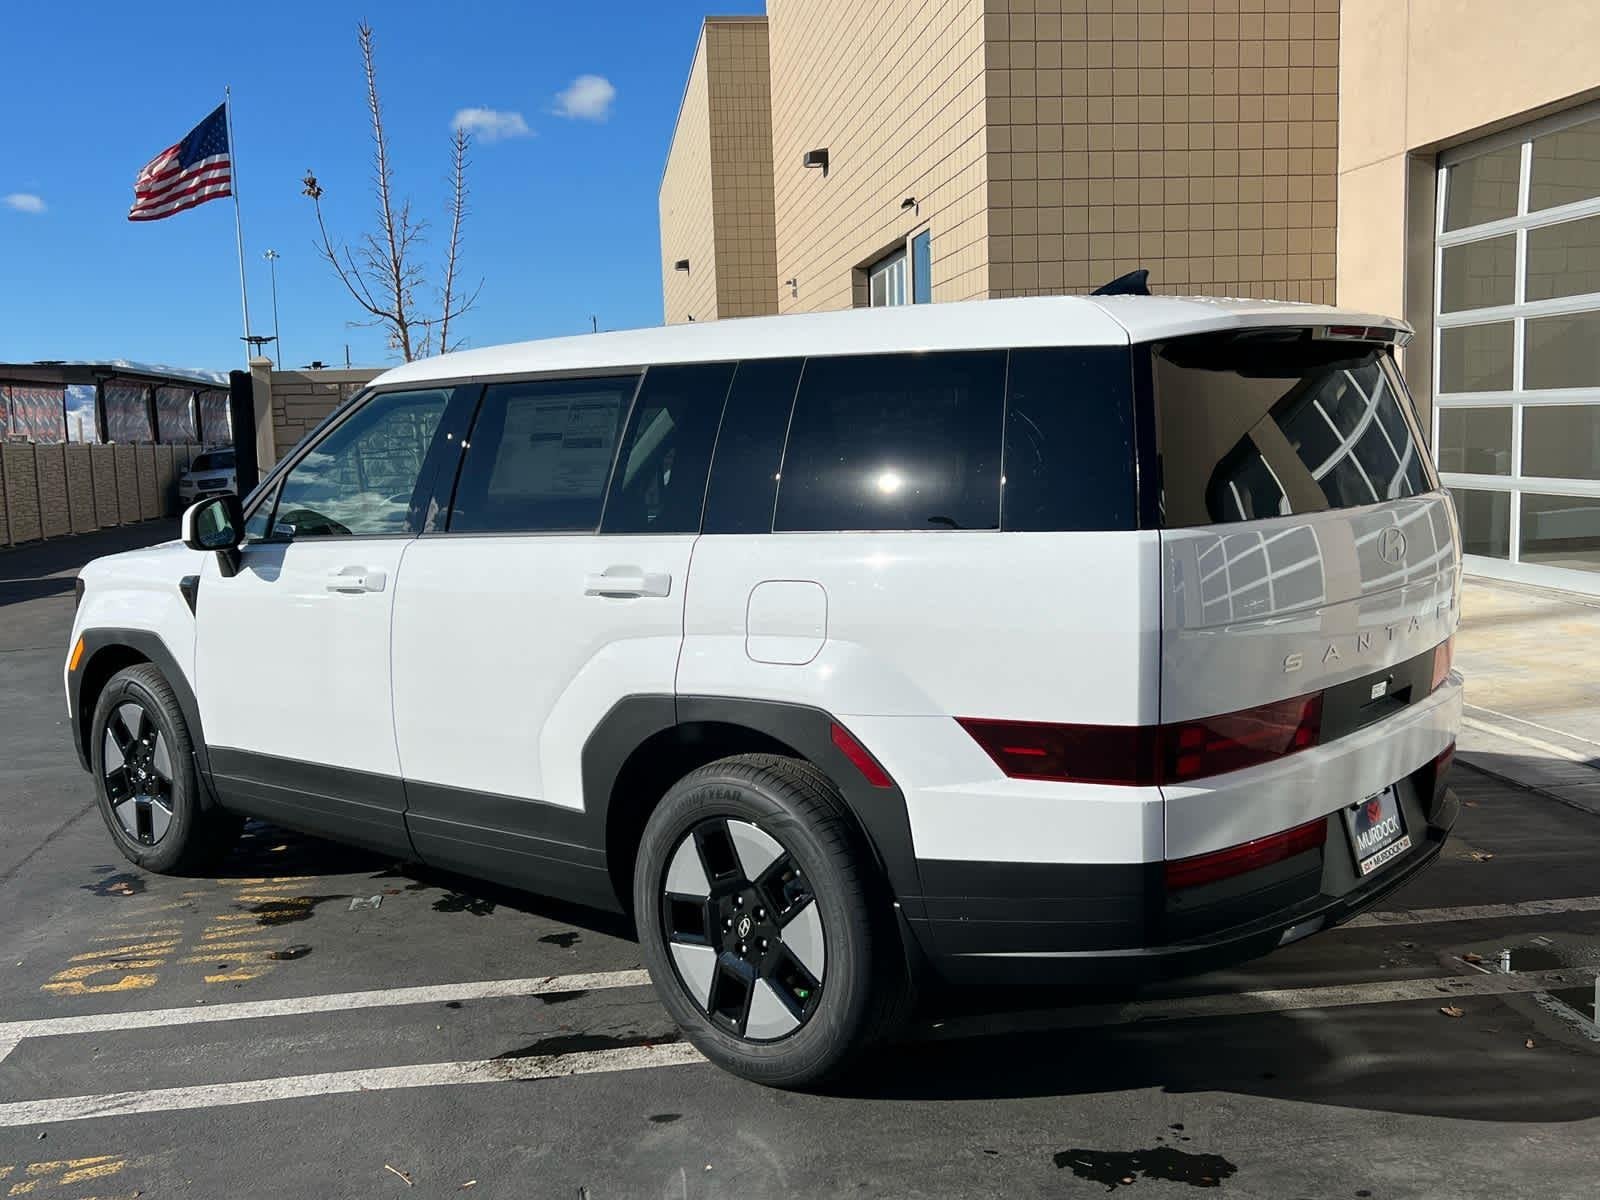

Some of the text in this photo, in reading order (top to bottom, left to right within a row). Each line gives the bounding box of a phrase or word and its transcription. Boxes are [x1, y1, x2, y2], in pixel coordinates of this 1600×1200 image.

[1283, 614, 1420, 673] SANTA
[1358, 815, 1399, 850] MURDOCK
[1373, 842, 1401, 866] MURDOCK
